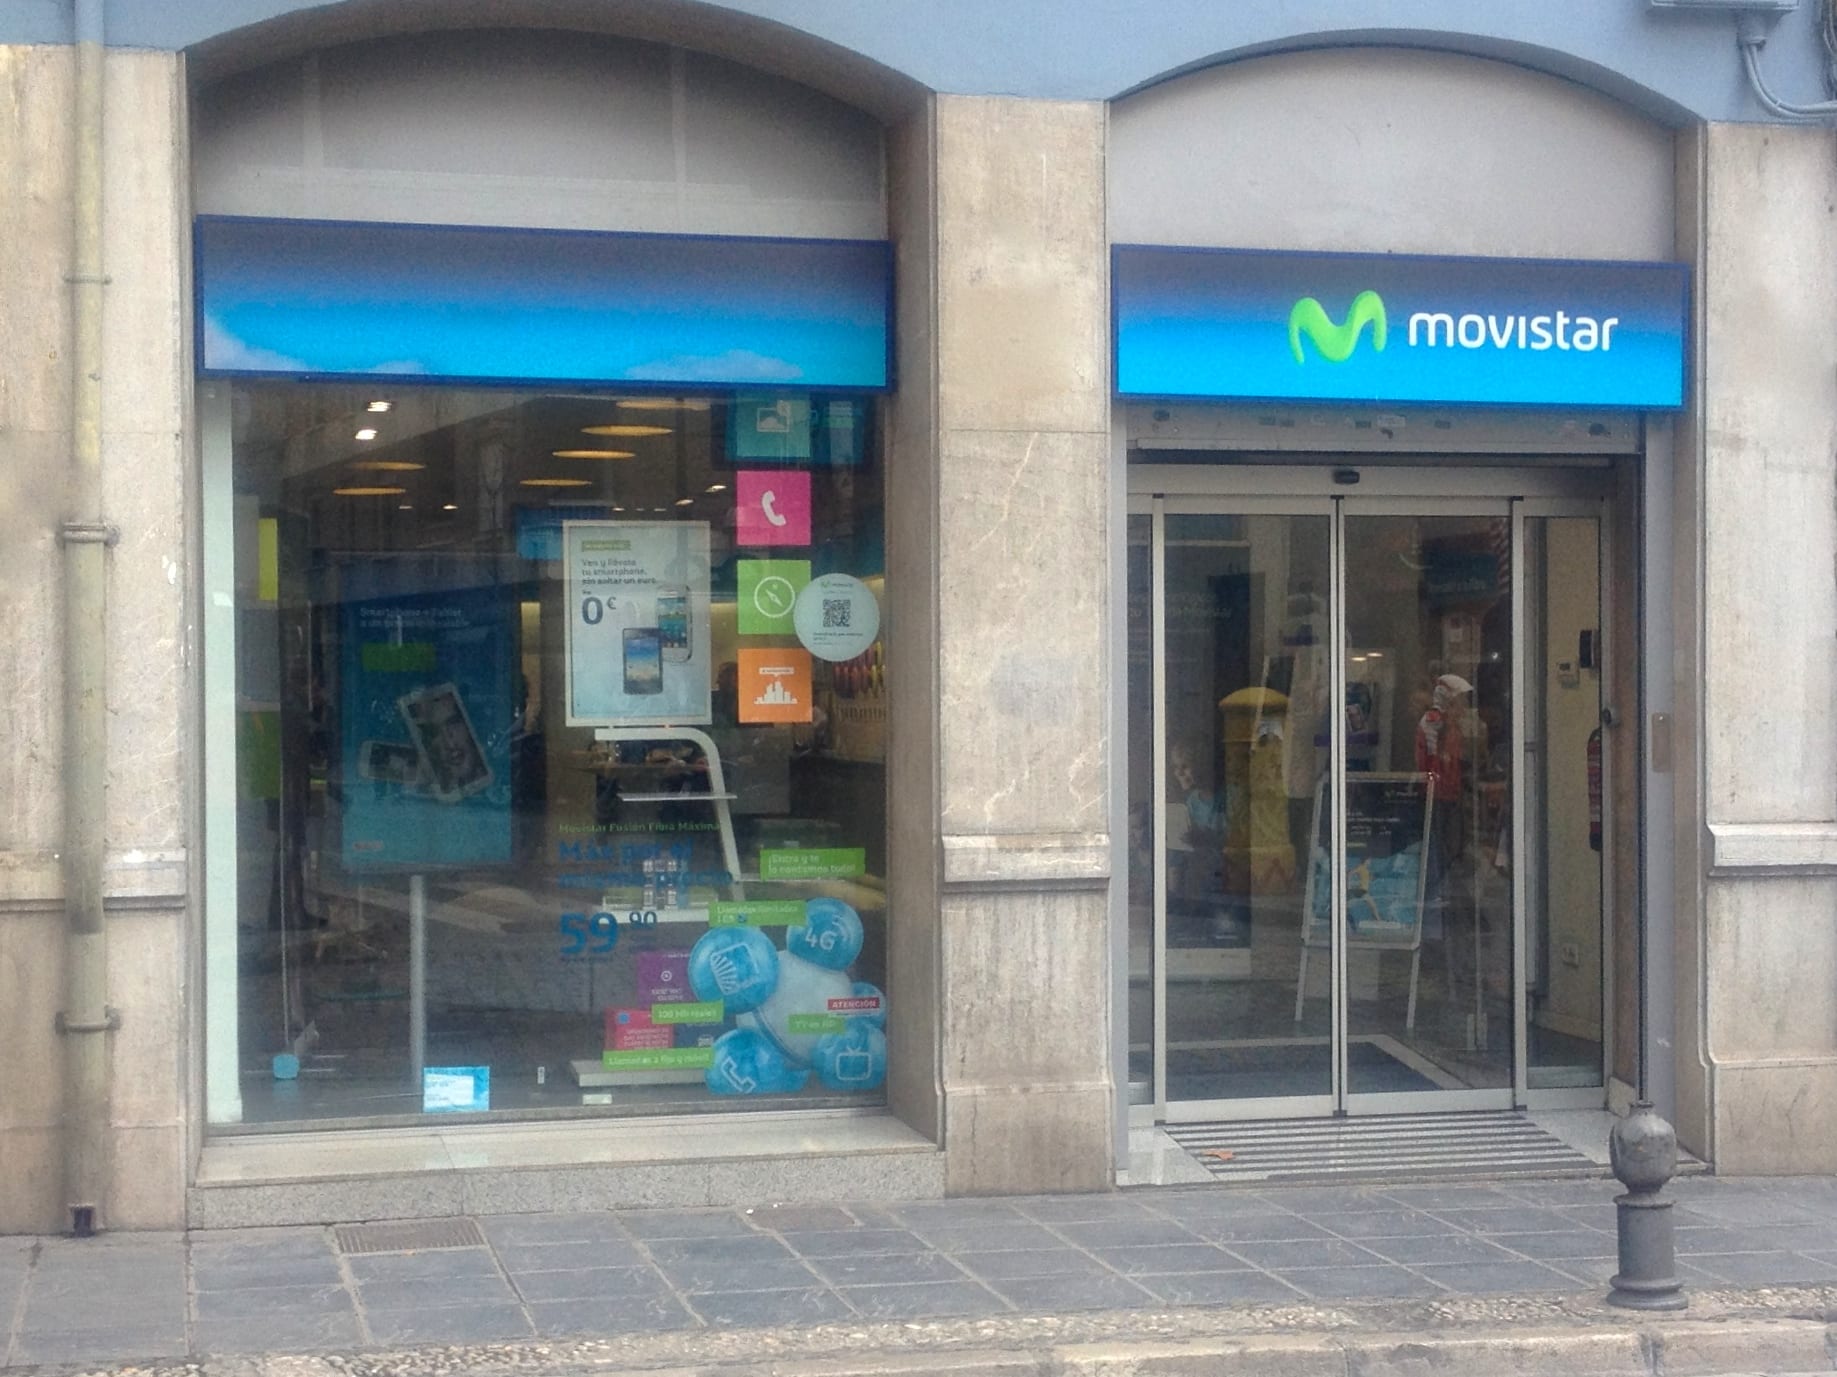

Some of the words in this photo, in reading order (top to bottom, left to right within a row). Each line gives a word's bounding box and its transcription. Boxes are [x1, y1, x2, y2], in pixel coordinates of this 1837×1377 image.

[1408, 311, 1618, 352] movistar
[559, 911, 619, 954] 59
[805, 930, 837, 950] 4G
[831, 999, 877, 1010] ATENCIÓN
